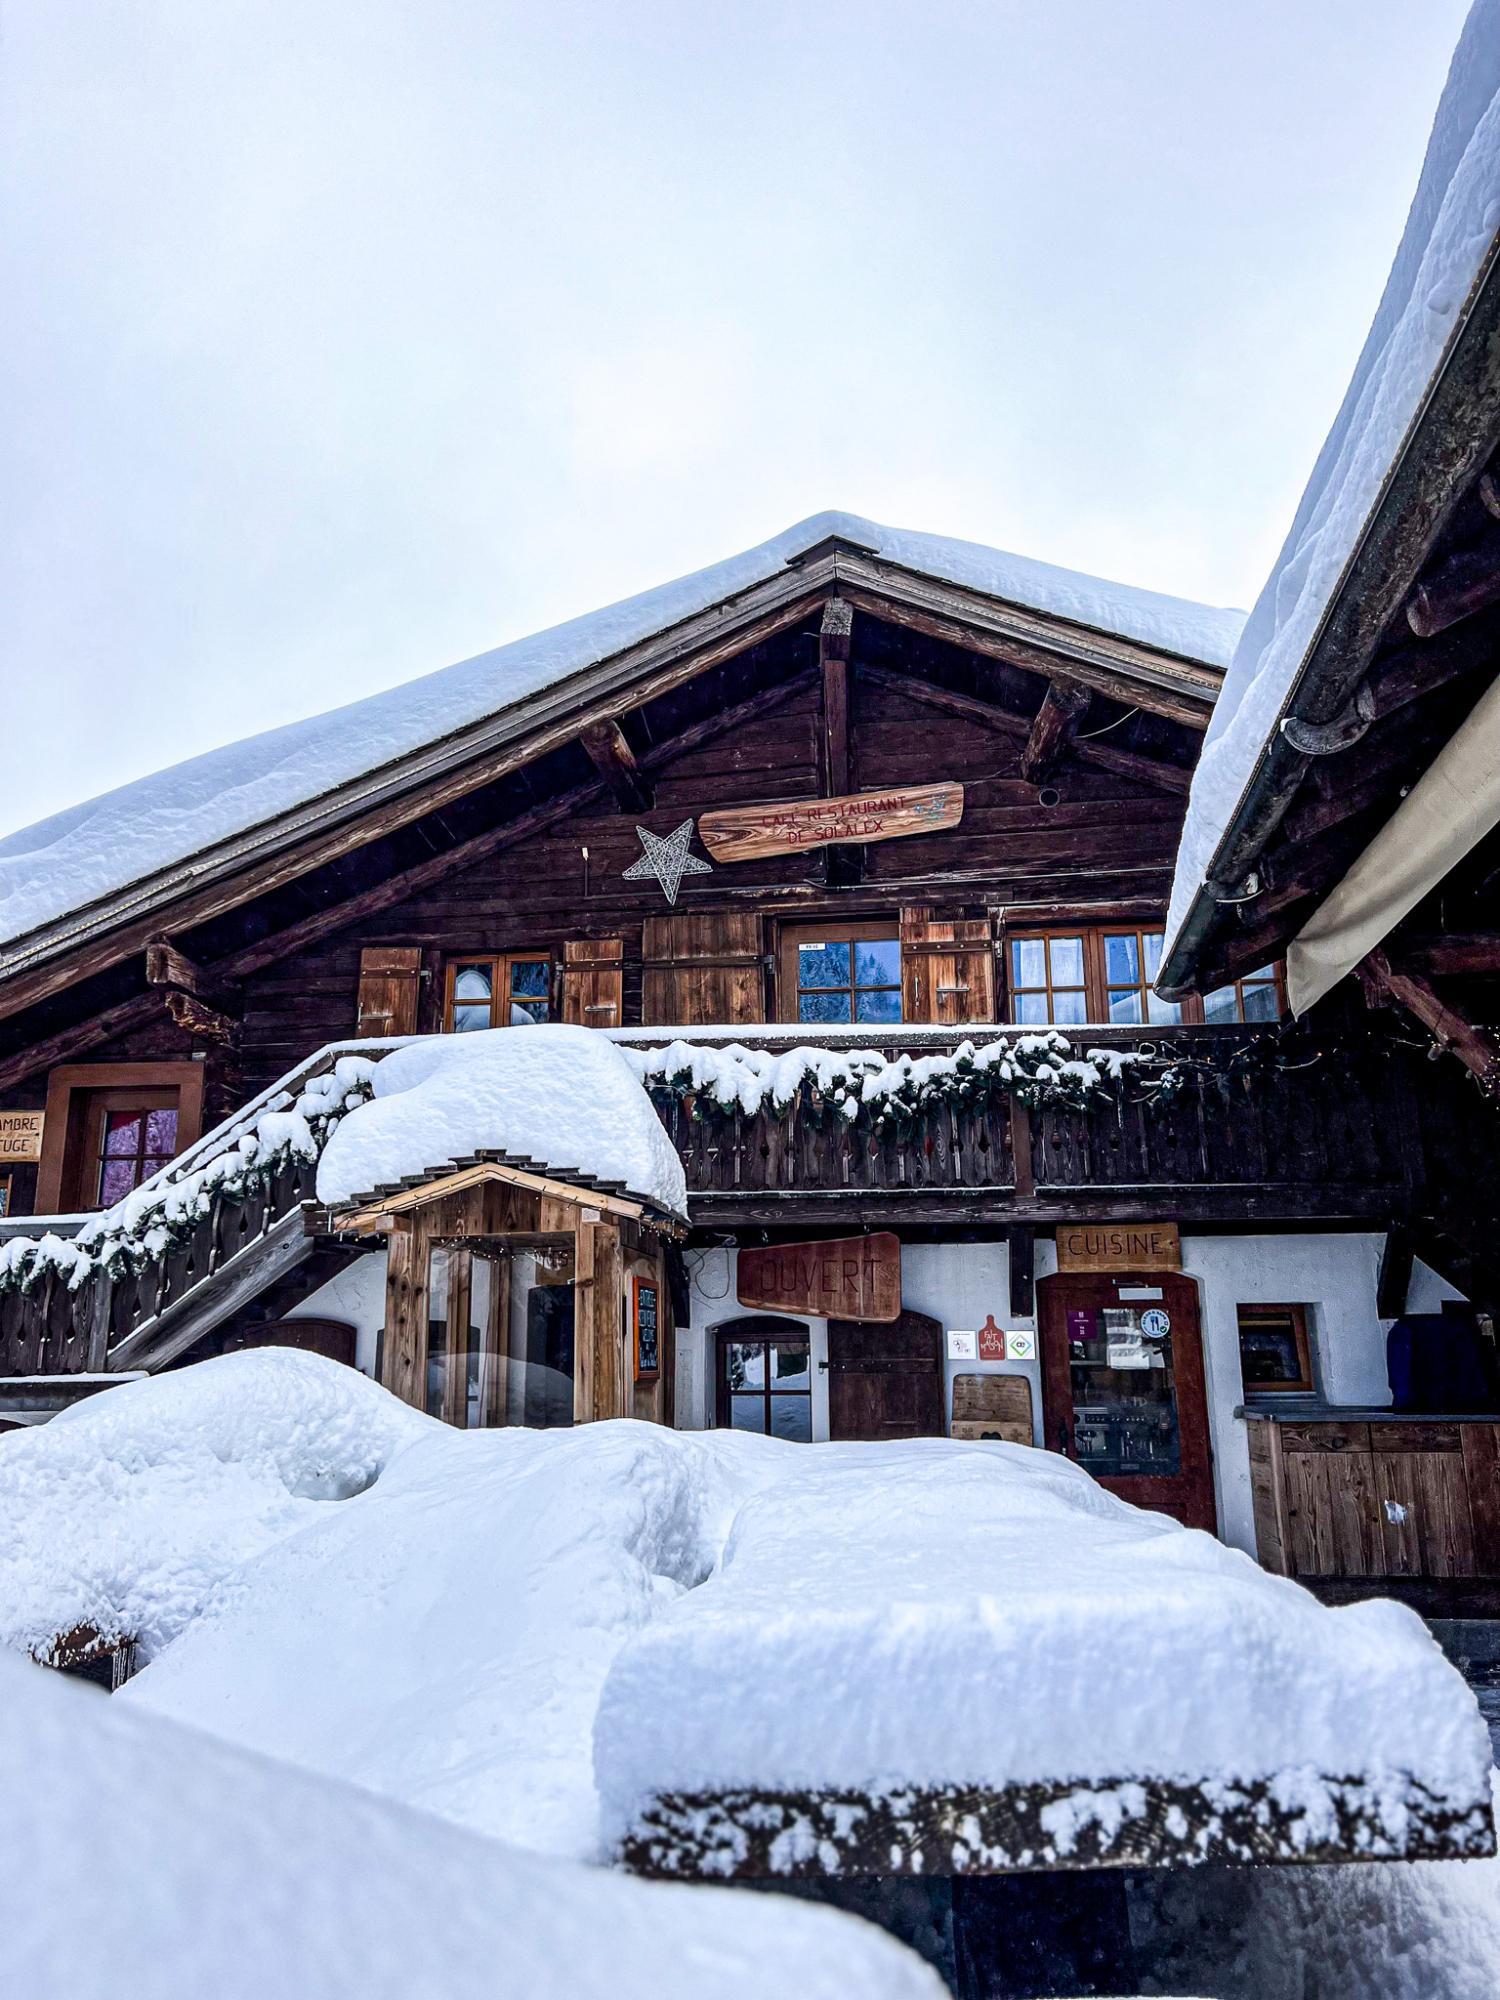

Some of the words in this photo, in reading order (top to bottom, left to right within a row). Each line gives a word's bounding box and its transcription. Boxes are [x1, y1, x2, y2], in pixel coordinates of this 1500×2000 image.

[807, 796, 906, 821] RESTAURANT
[788, 830, 807, 844] DE
[814, 818, 884, 841] SOLALEX
[0, 1139, 30, 1152] UGE
[1068, 1232, 1163, 1255] CUISINE
[760, 1257, 882, 1293] OUVERT
[980, 1337, 1004, 1352] MAISON
[984, 1329, 998, 1341] FAIT
